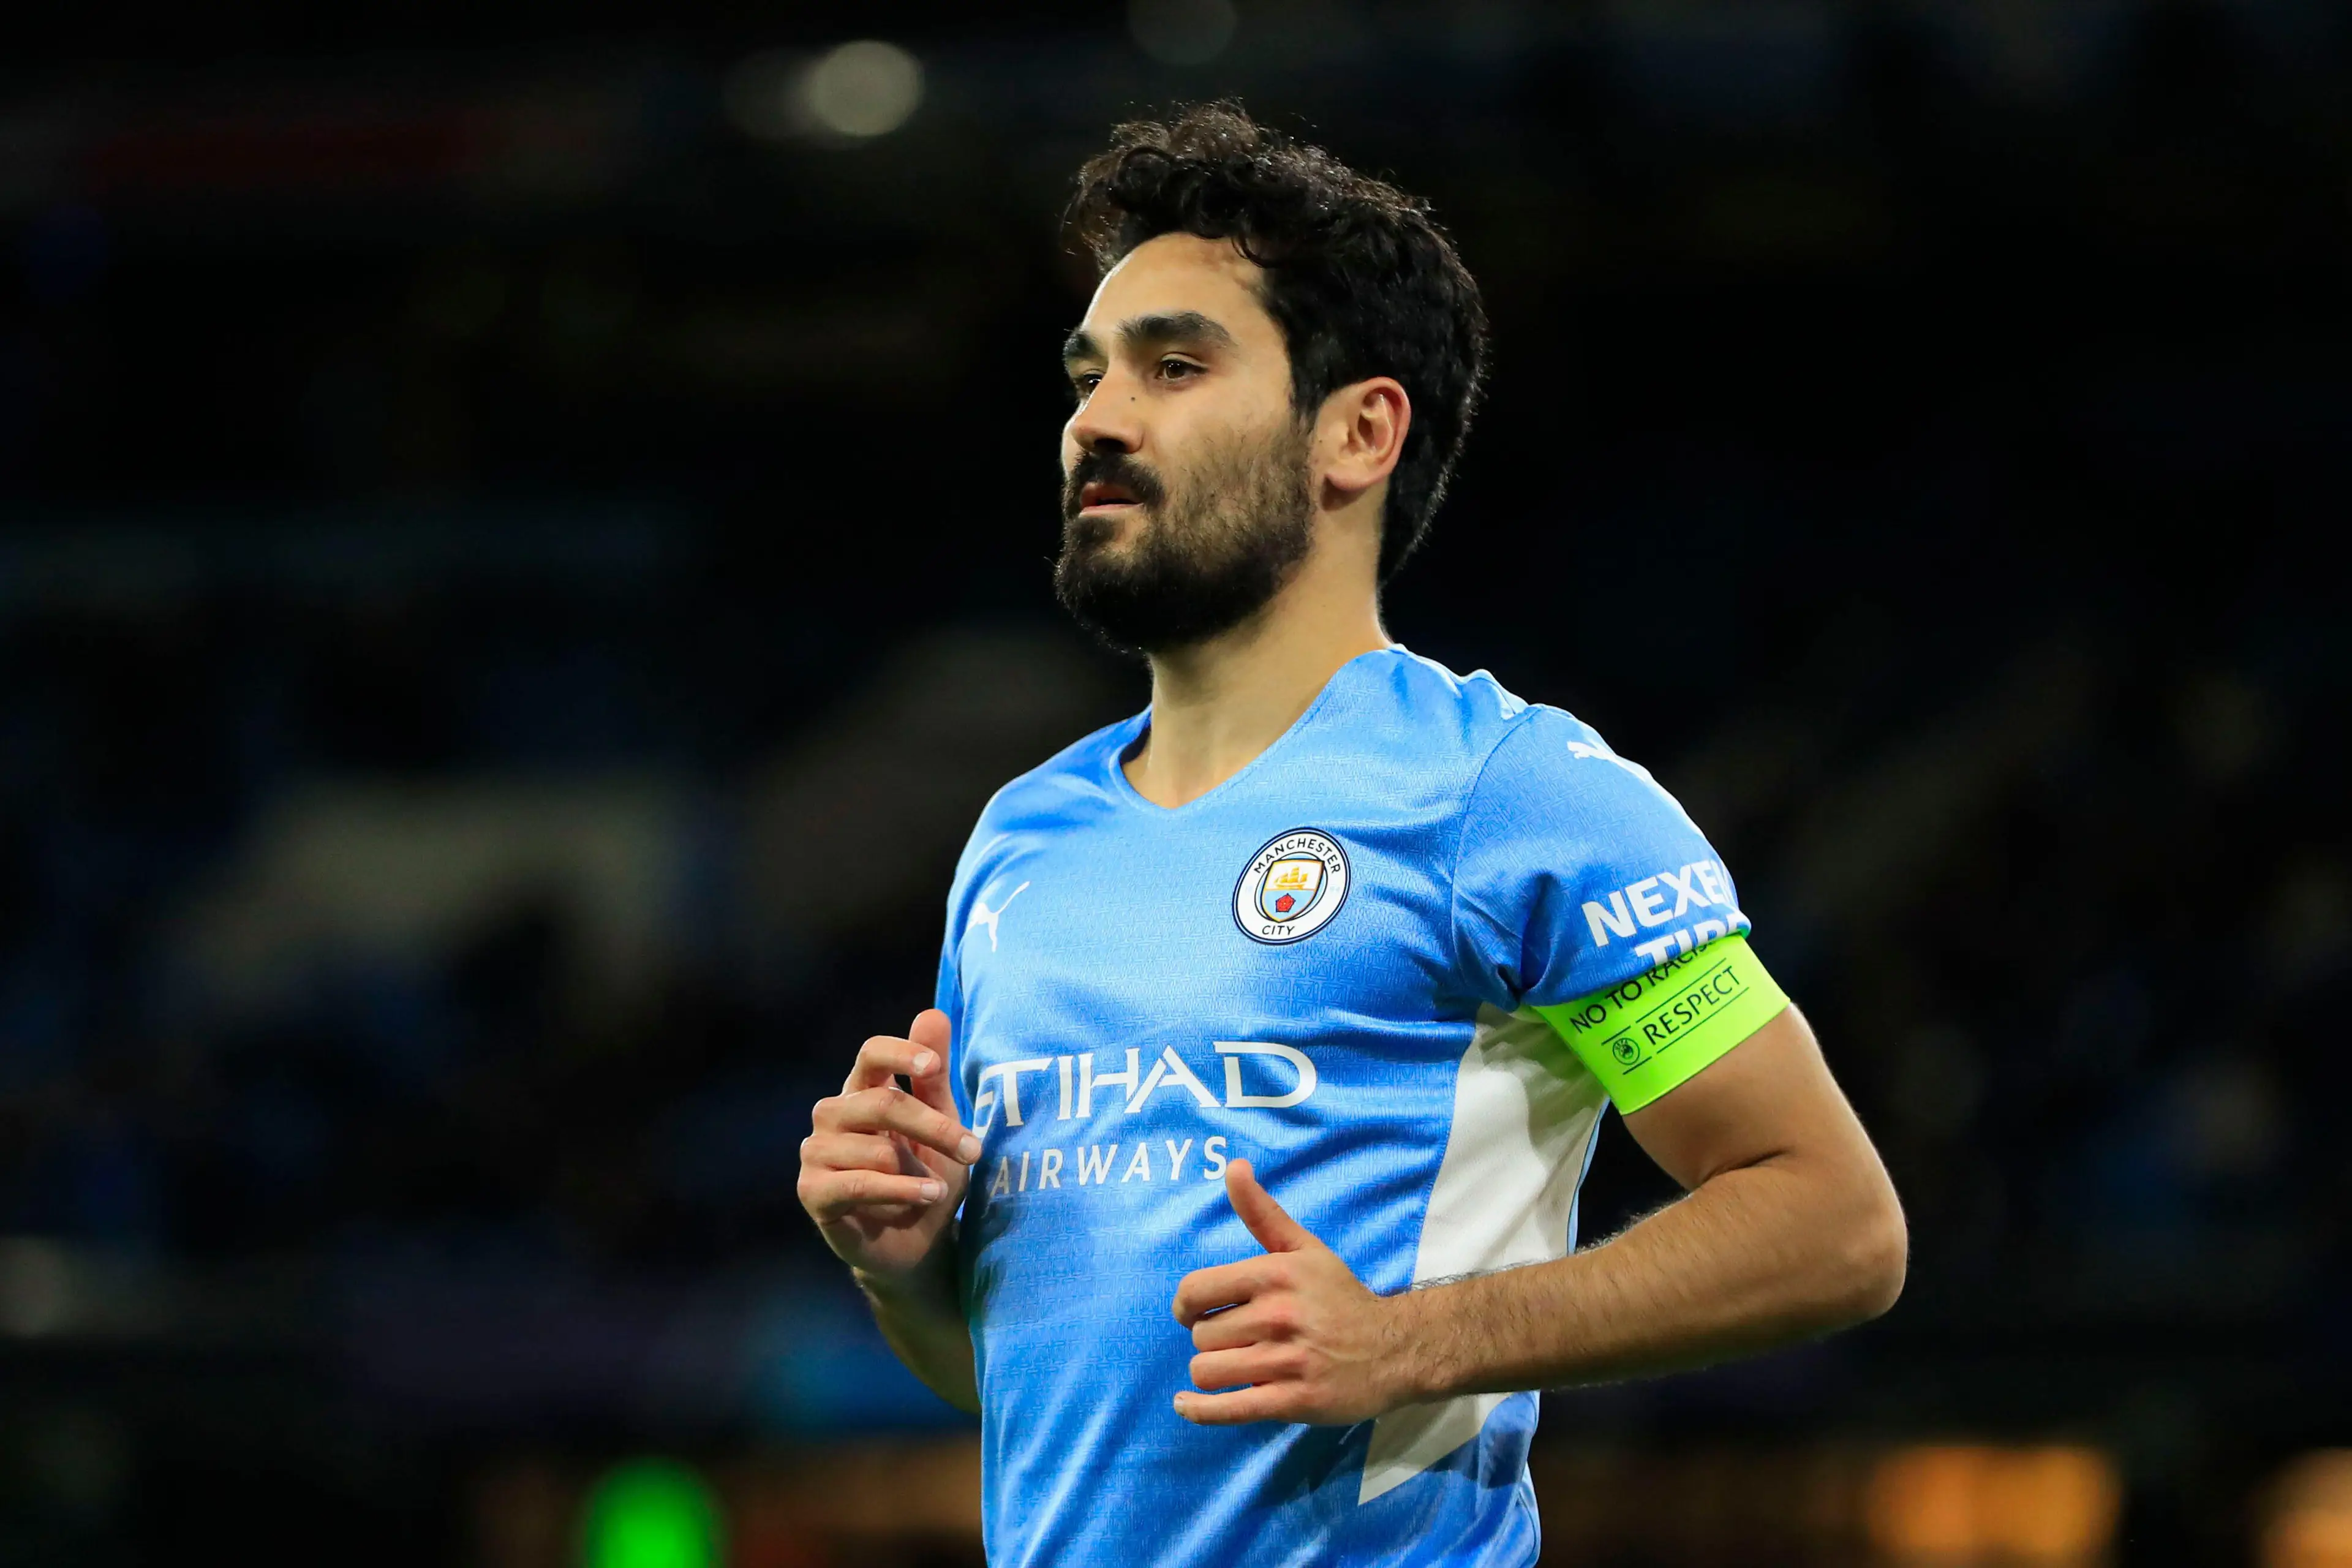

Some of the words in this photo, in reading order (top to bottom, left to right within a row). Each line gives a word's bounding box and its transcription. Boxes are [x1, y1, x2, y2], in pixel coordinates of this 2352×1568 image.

[1254, 837, 1341, 874] MANCHESTER
[1262, 925, 1295, 935] CITY
[1581, 860, 1732, 948] NEXE
[1569, 1004, 1607, 1034] NO
[1605, 980, 1643, 1009] TO
[1642, 965, 1740, 1046] RESPECT
[990, 1136, 1227, 1198] AIRWAYS
